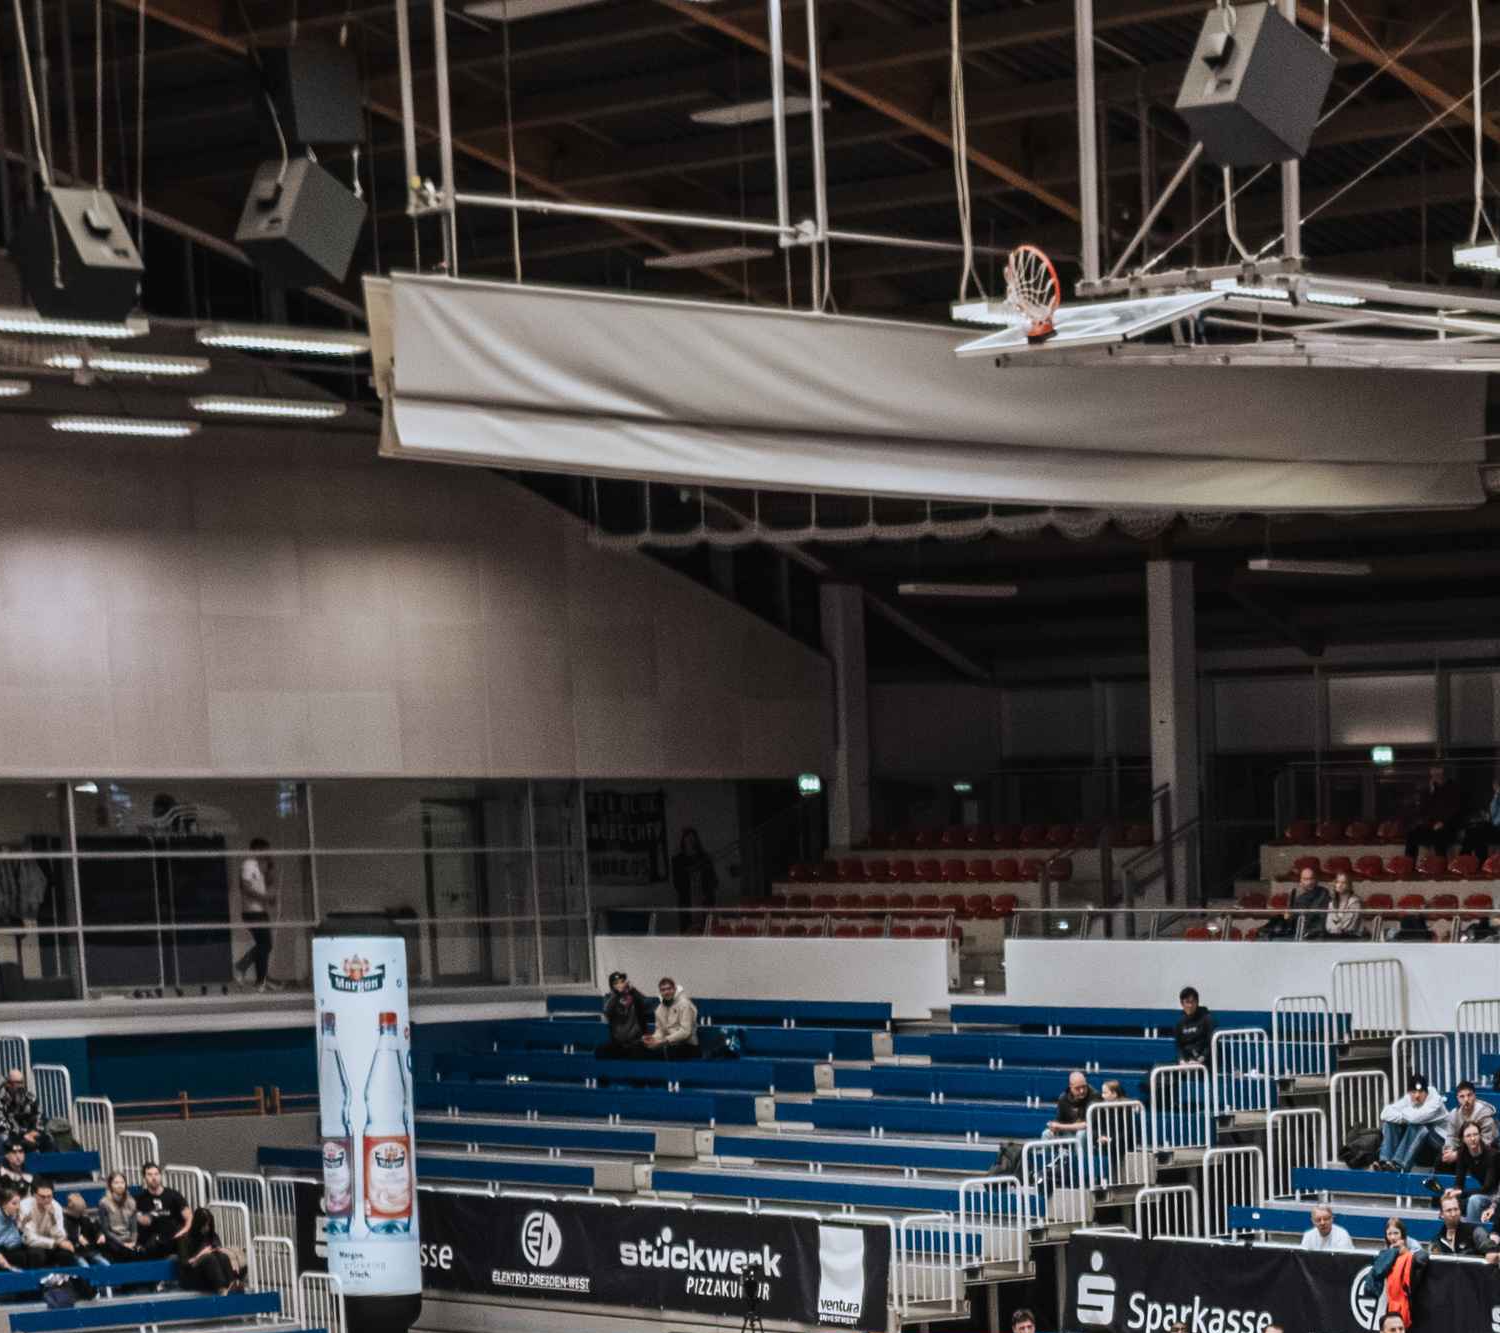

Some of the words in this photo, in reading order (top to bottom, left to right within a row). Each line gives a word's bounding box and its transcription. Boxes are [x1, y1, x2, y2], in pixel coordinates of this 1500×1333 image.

[333, 977, 381, 994] Margon
[820, 1297, 861, 1315] ventura
[819, 1314, 859, 1326] INVESTMENT
